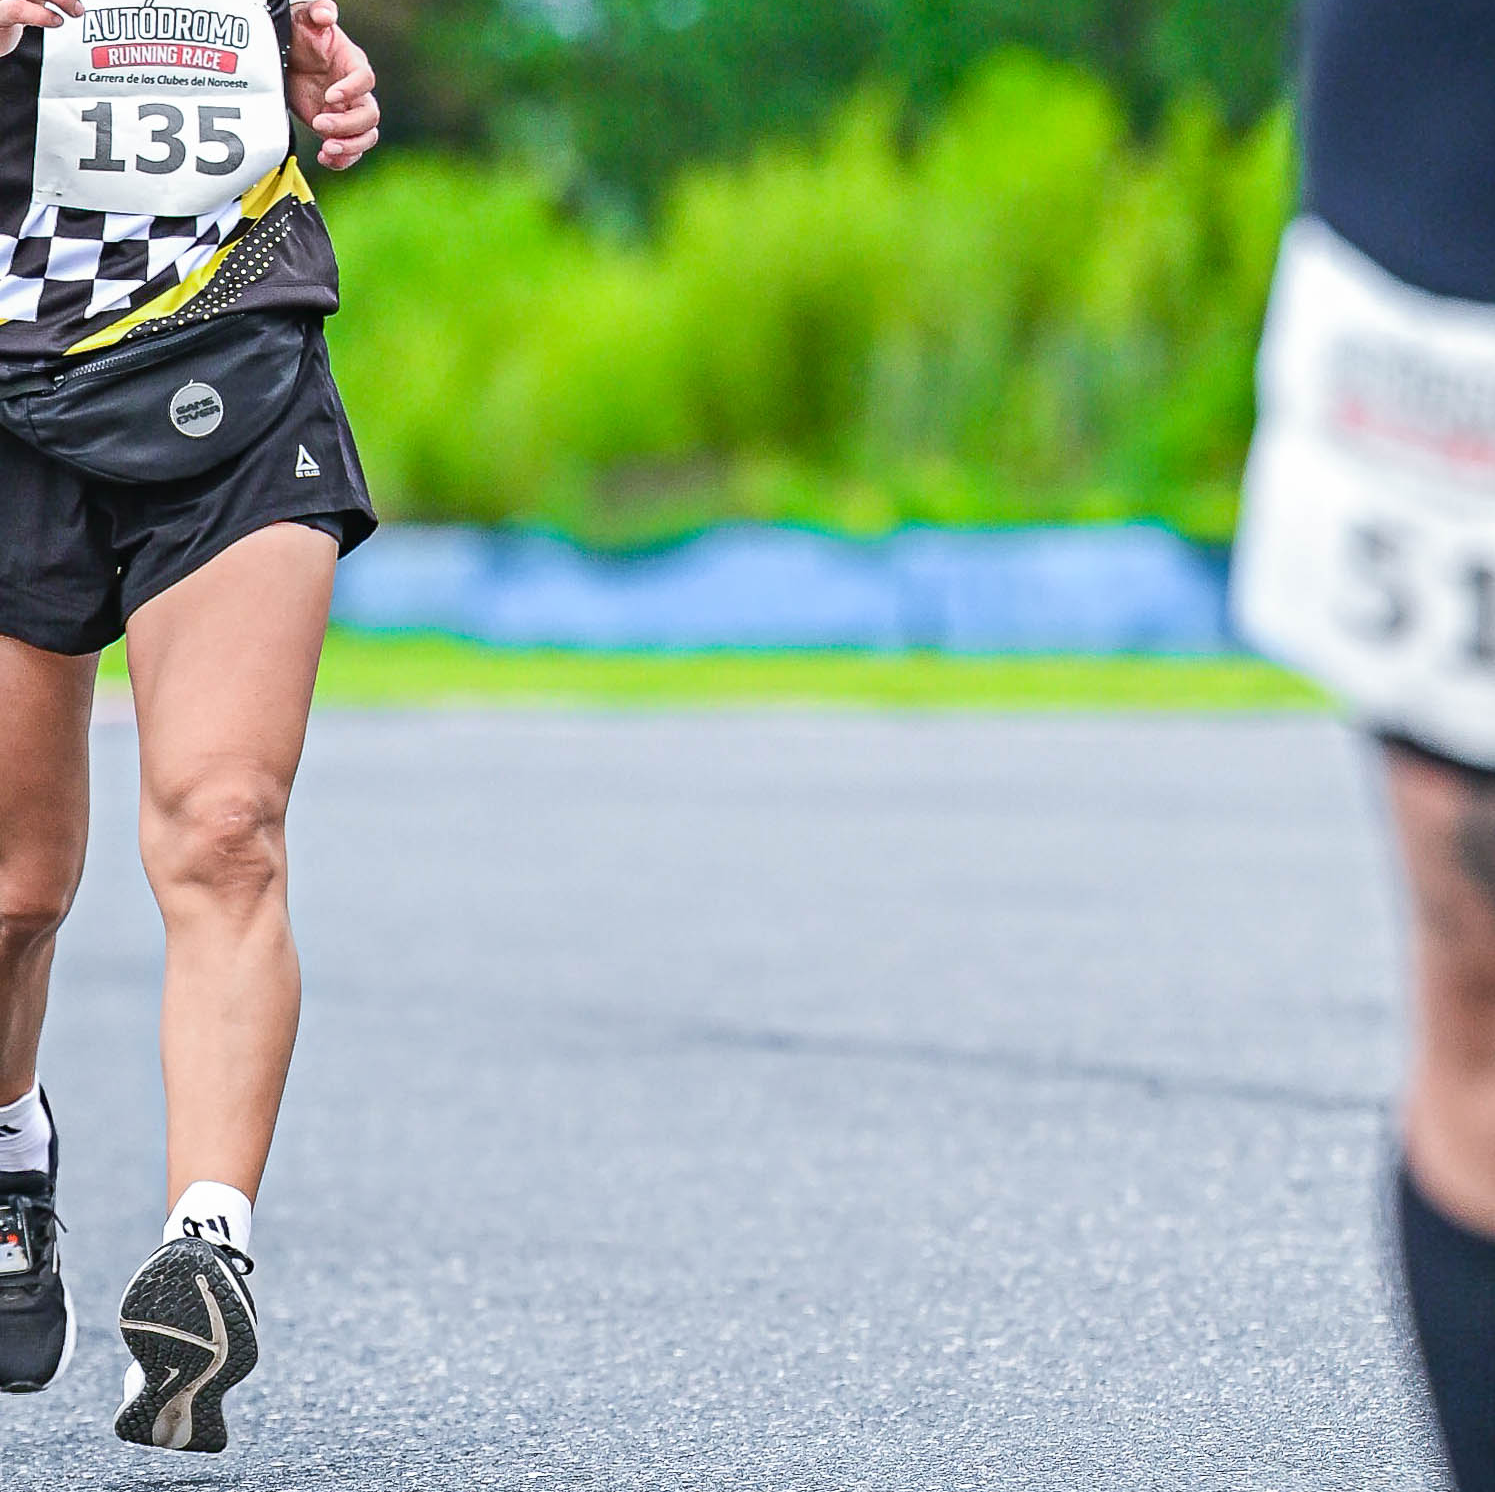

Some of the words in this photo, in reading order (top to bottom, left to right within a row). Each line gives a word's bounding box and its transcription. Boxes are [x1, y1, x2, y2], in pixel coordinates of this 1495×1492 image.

[107, 46, 178, 66] RUNNING
[181, 48, 222, 70] RACE
[75, 71, 87, 82] La
[88, 72, 124, 84] Carrera
[126, 73, 140, 84] de
[141, 73, 155, 85] los
[156, 74, 189, 86] Clubes
[191, 75, 206, 87] del
[207, 77, 249, 89] Noroeste
[78, 101, 246, 176] 135
[175, 396, 215, 415] GAME
[176, 404, 221, 425] OVER
